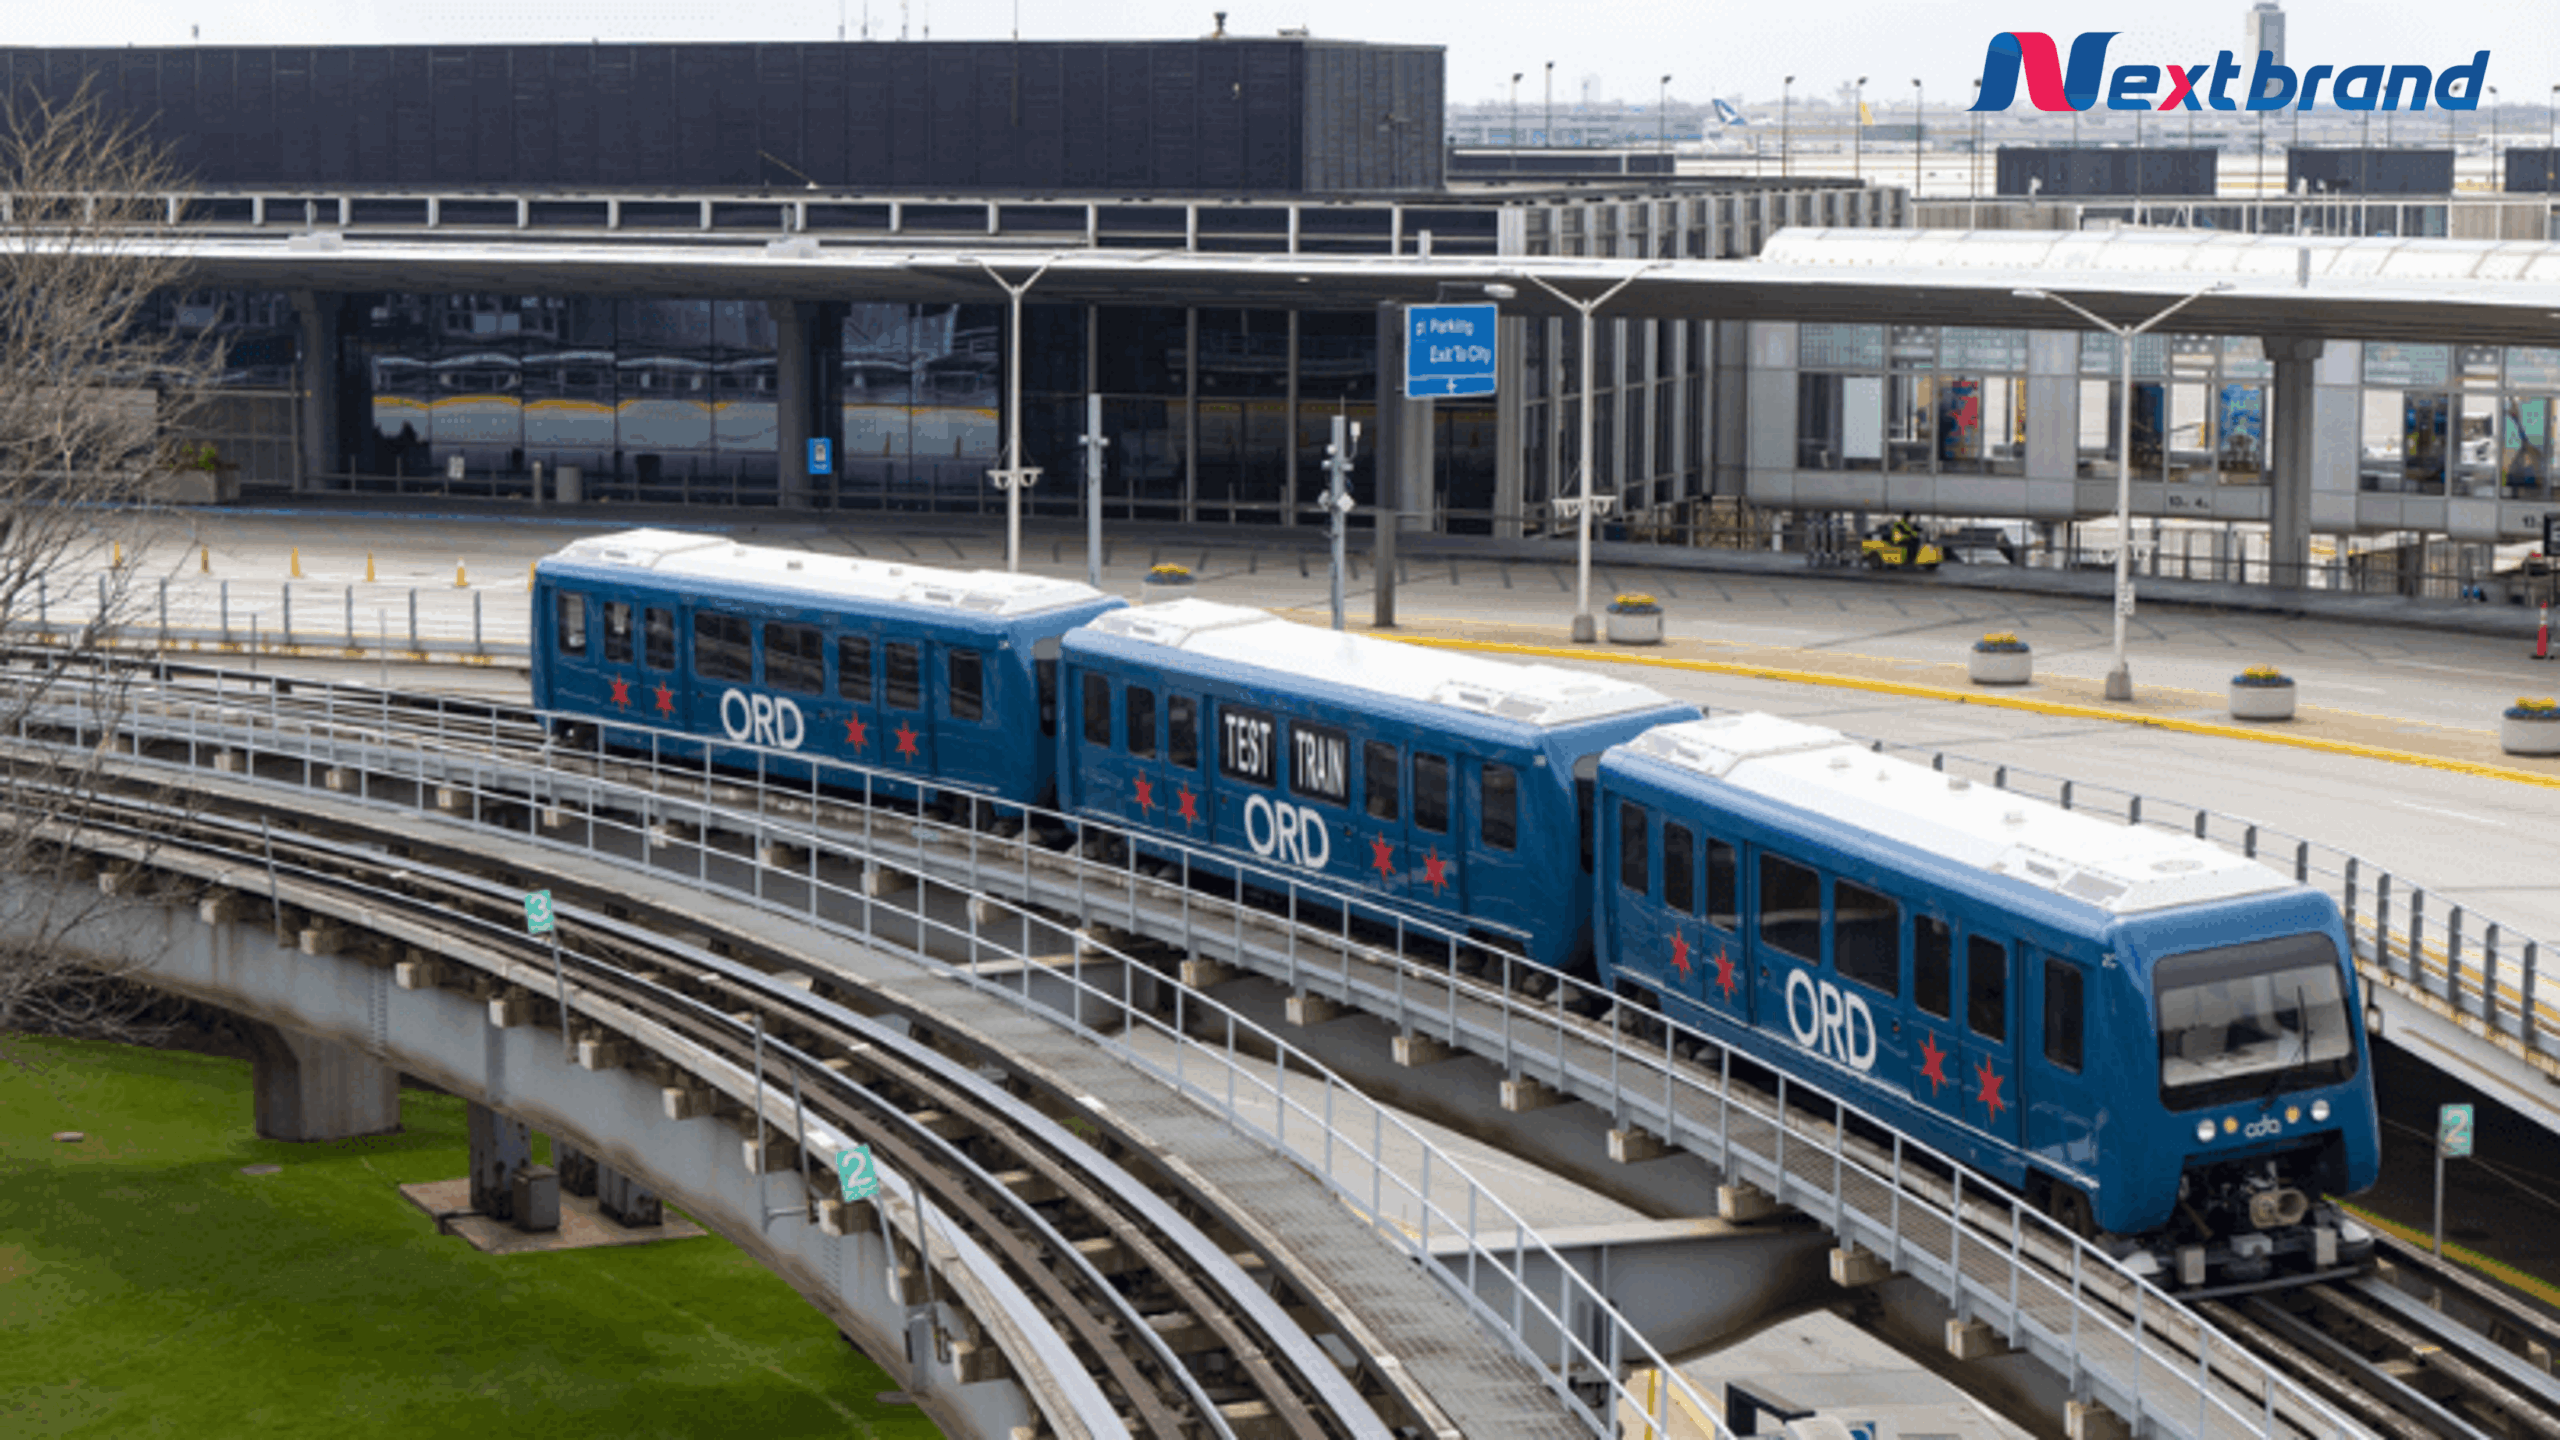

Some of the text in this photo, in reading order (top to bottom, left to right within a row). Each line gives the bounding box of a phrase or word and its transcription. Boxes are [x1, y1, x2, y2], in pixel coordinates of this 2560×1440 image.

[1430, 318, 1474, 336] Parking
[1468, 345, 1491, 365] City
[721, 688, 804, 749] ORD
[1225, 713, 1345, 798] TEST TRAIN
[1244, 794, 1329, 869] ORD
[530, 894, 550, 923] 3
[1785, 967, 1876, 1072] ORD
[2444, 1108, 2468, 1144] 2
[841, 1152, 872, 1188] 2
